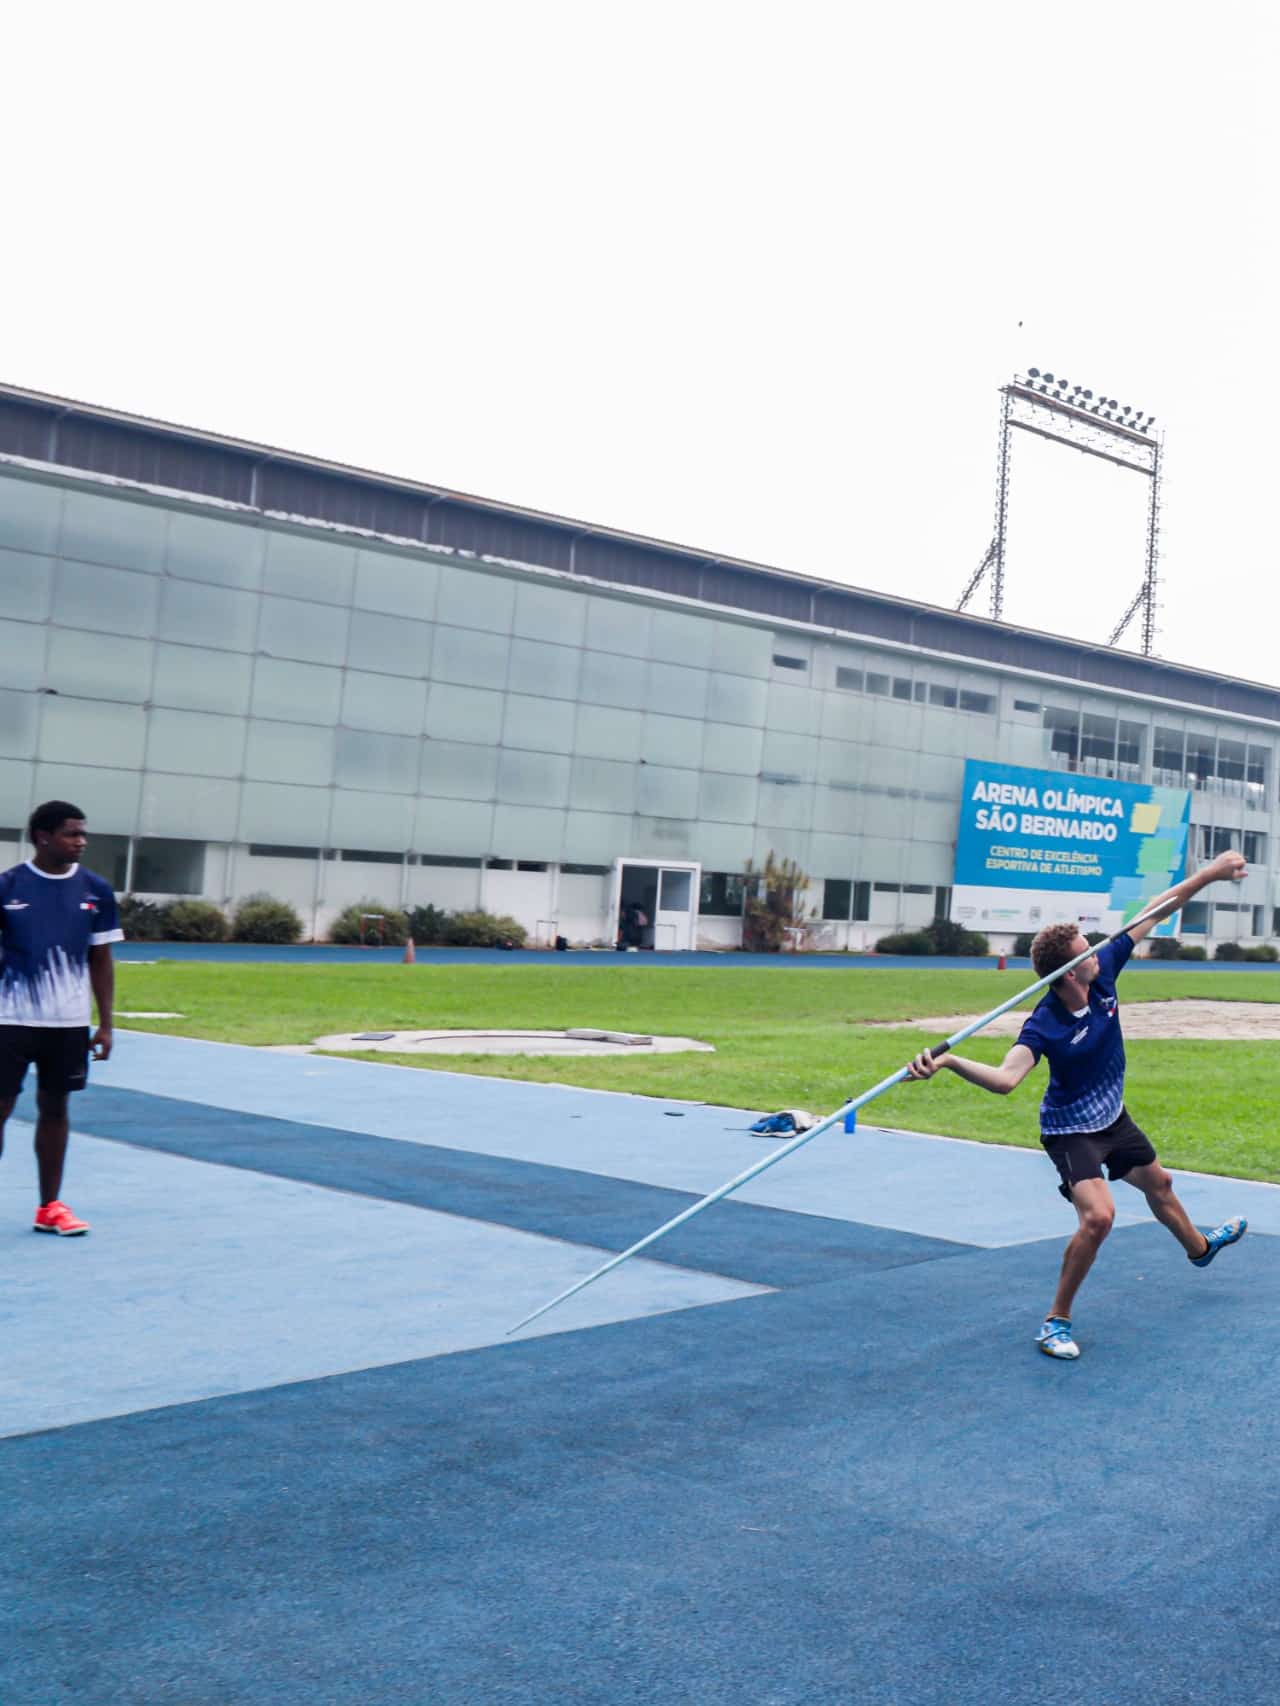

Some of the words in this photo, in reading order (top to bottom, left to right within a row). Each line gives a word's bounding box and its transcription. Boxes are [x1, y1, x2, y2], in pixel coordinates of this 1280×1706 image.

[971, 780, 1039, 808] ARENA
[1042, 788, 1124, 818] OLÍMPICA
[975, 805, 1017, 833] SÃO
[1020, 813, 1117, 842] BERNARDO
[985, 858, 1038, 872] ESPORTIVA
[1040, 862, 1053, 873] DE
[1054, 864, 1102, 876] ATLETISMO
[990, 846, 1028, 859] CENTRO
[1030, 848, 1043, 860] DE
[1044, 850, 1099, 864] EXCELÊNCIA
